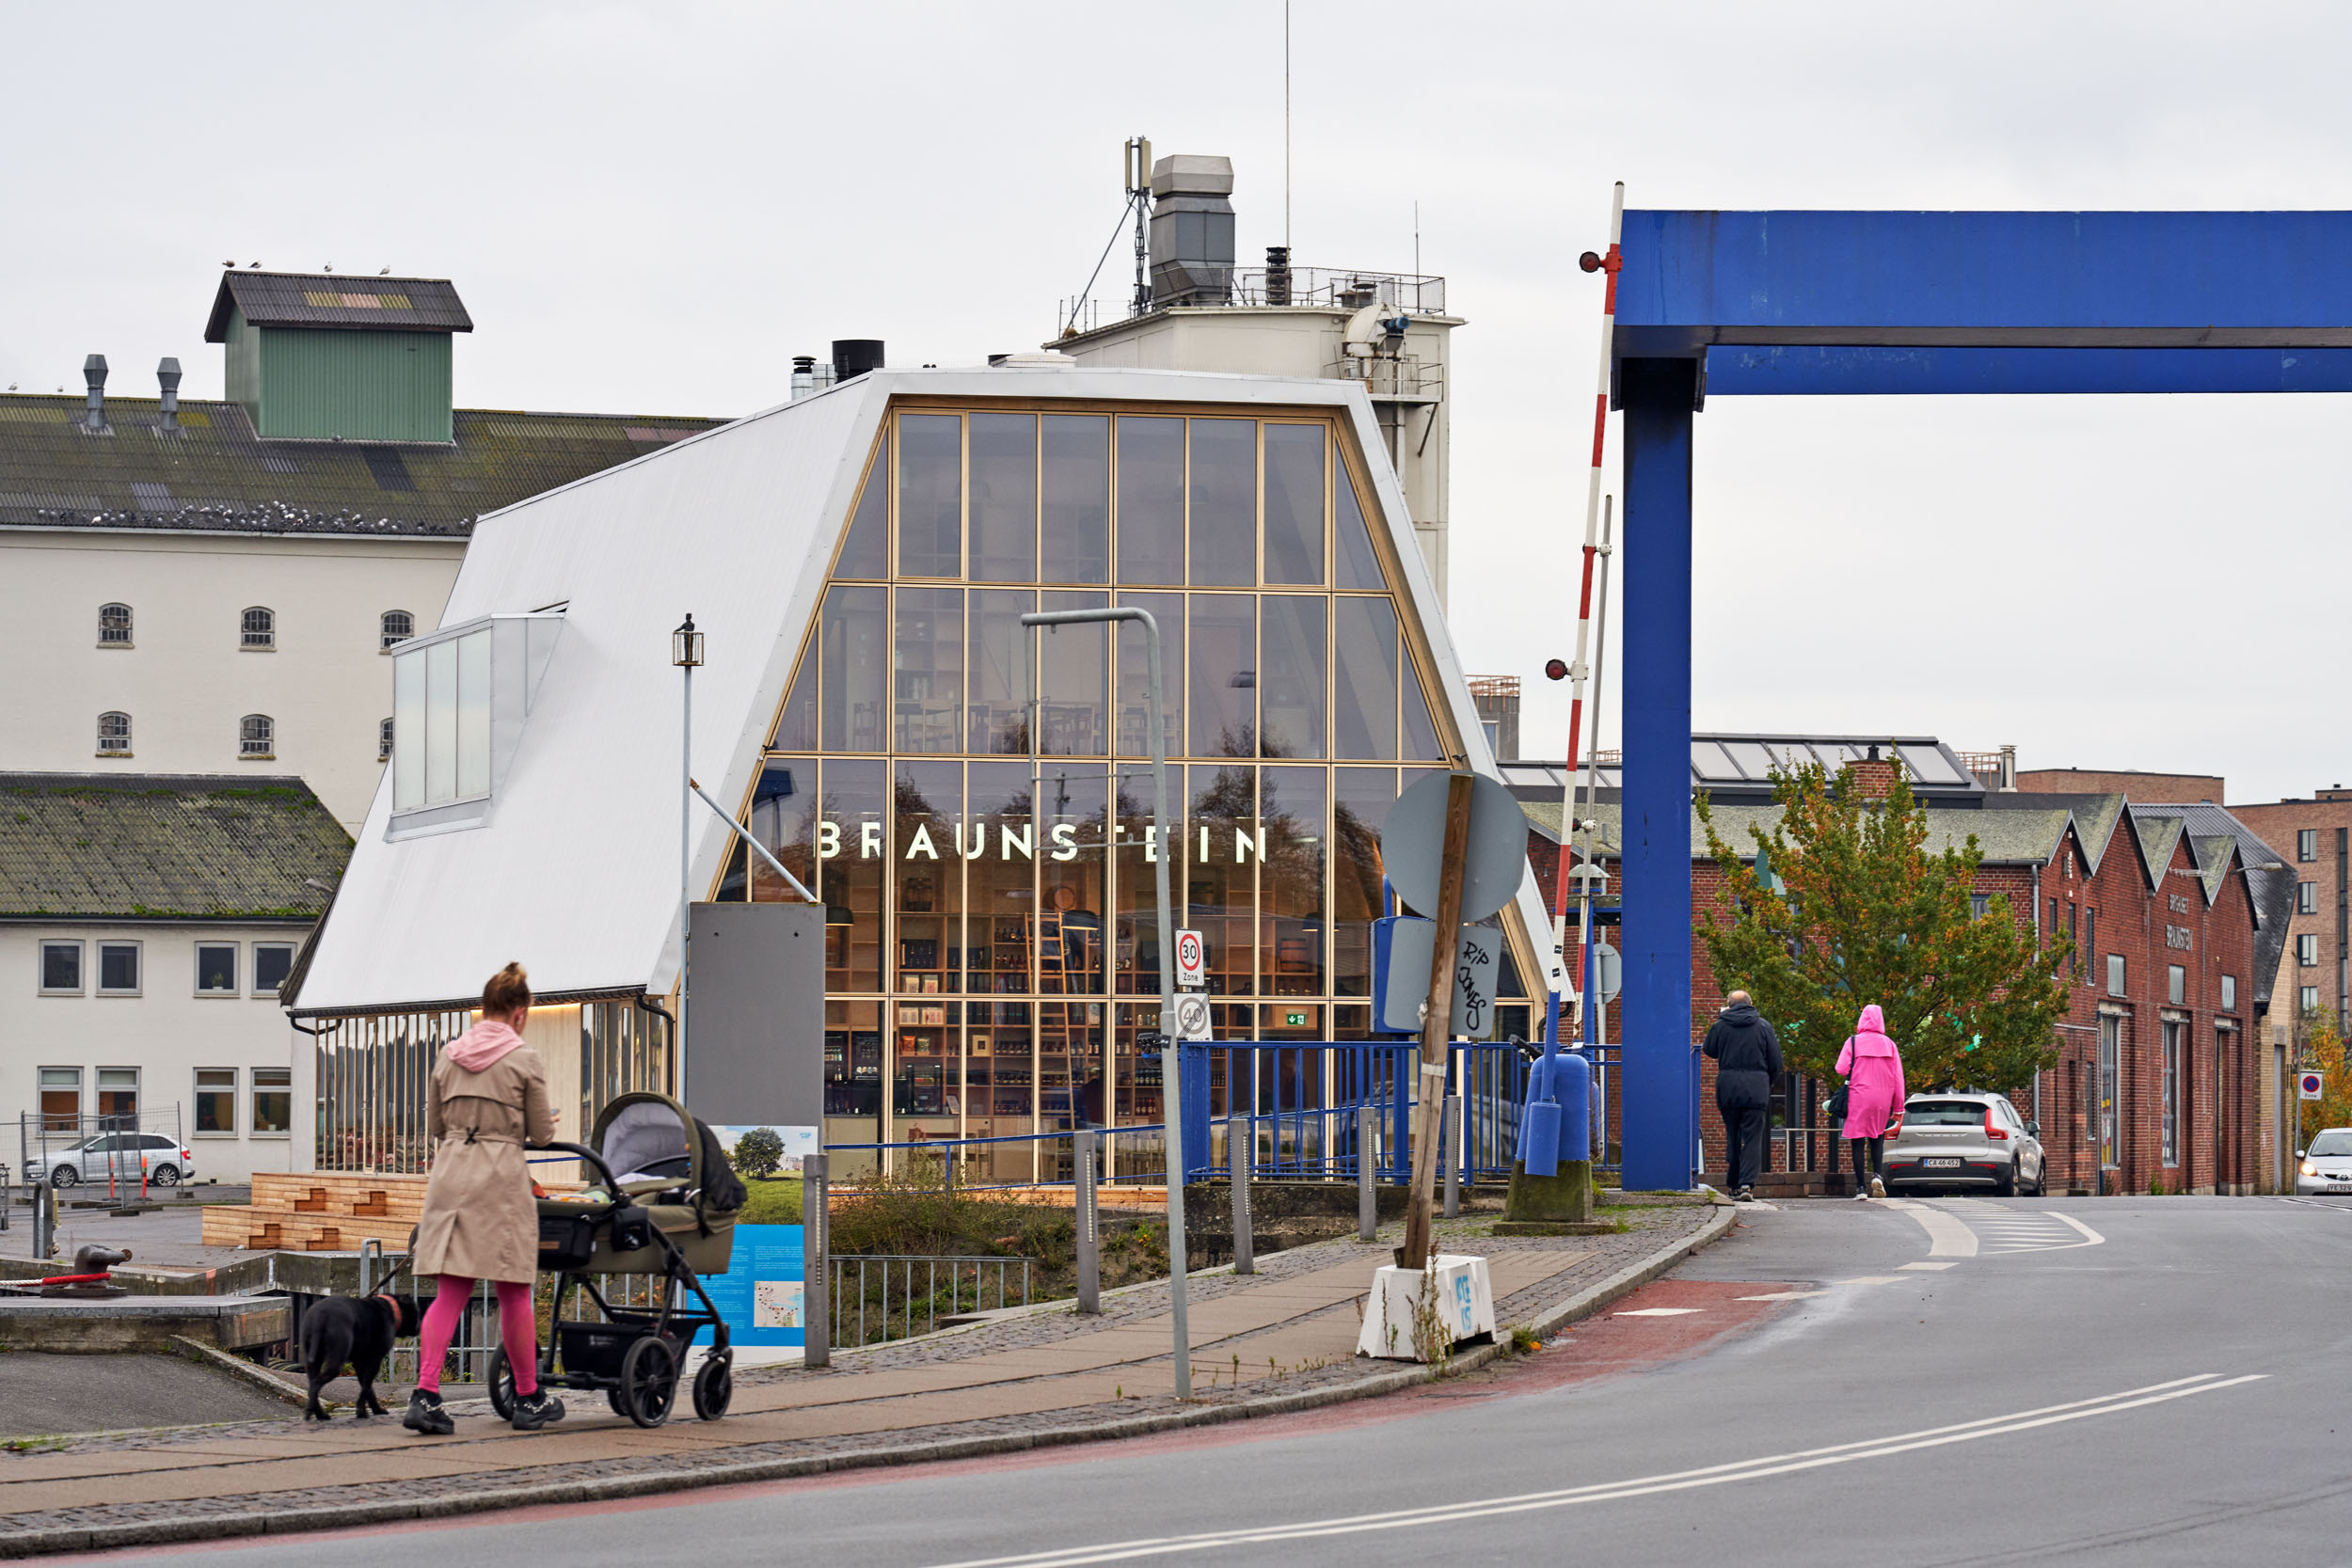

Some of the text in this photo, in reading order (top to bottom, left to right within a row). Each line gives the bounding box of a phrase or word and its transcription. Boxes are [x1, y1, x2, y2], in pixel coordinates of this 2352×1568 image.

[814, 821, 1266, 863] BRAUNSEIN
[1183, 944, 1197, 959] 30
[1183, 973, 1199, 982] Zone
